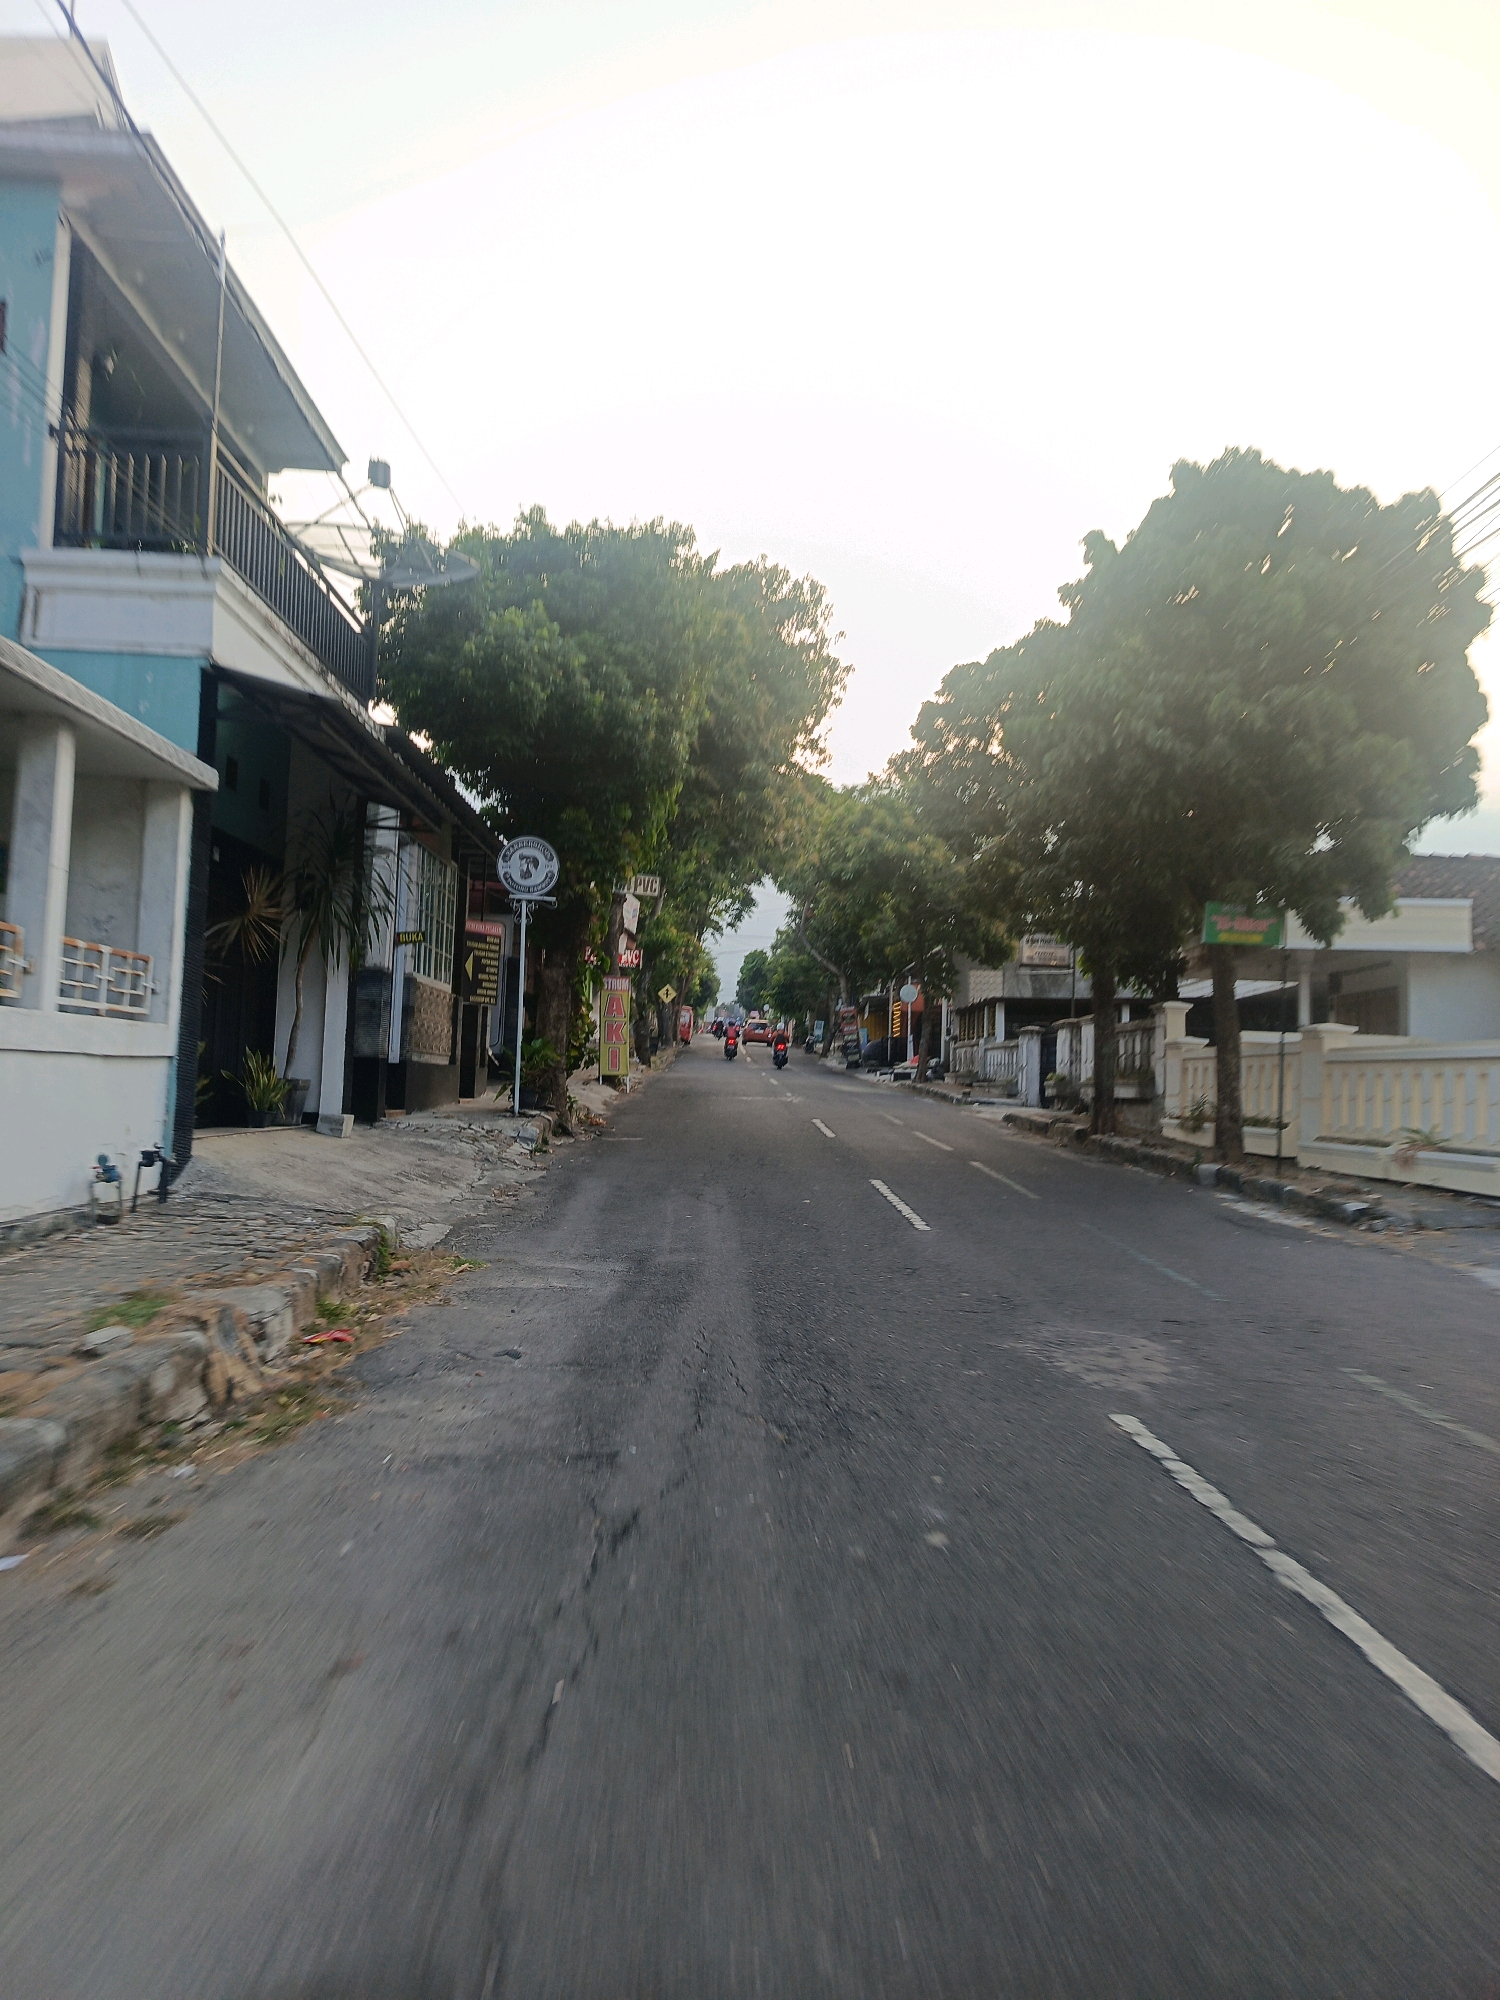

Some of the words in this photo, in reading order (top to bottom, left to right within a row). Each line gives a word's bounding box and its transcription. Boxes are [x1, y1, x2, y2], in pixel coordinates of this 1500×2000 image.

[635, 877, 658, 894] PVC
[399, 931, 424, 943] BUKA
[603, 978, 629, 991] STRUM
[604, 993, 627, 1072] AKI
